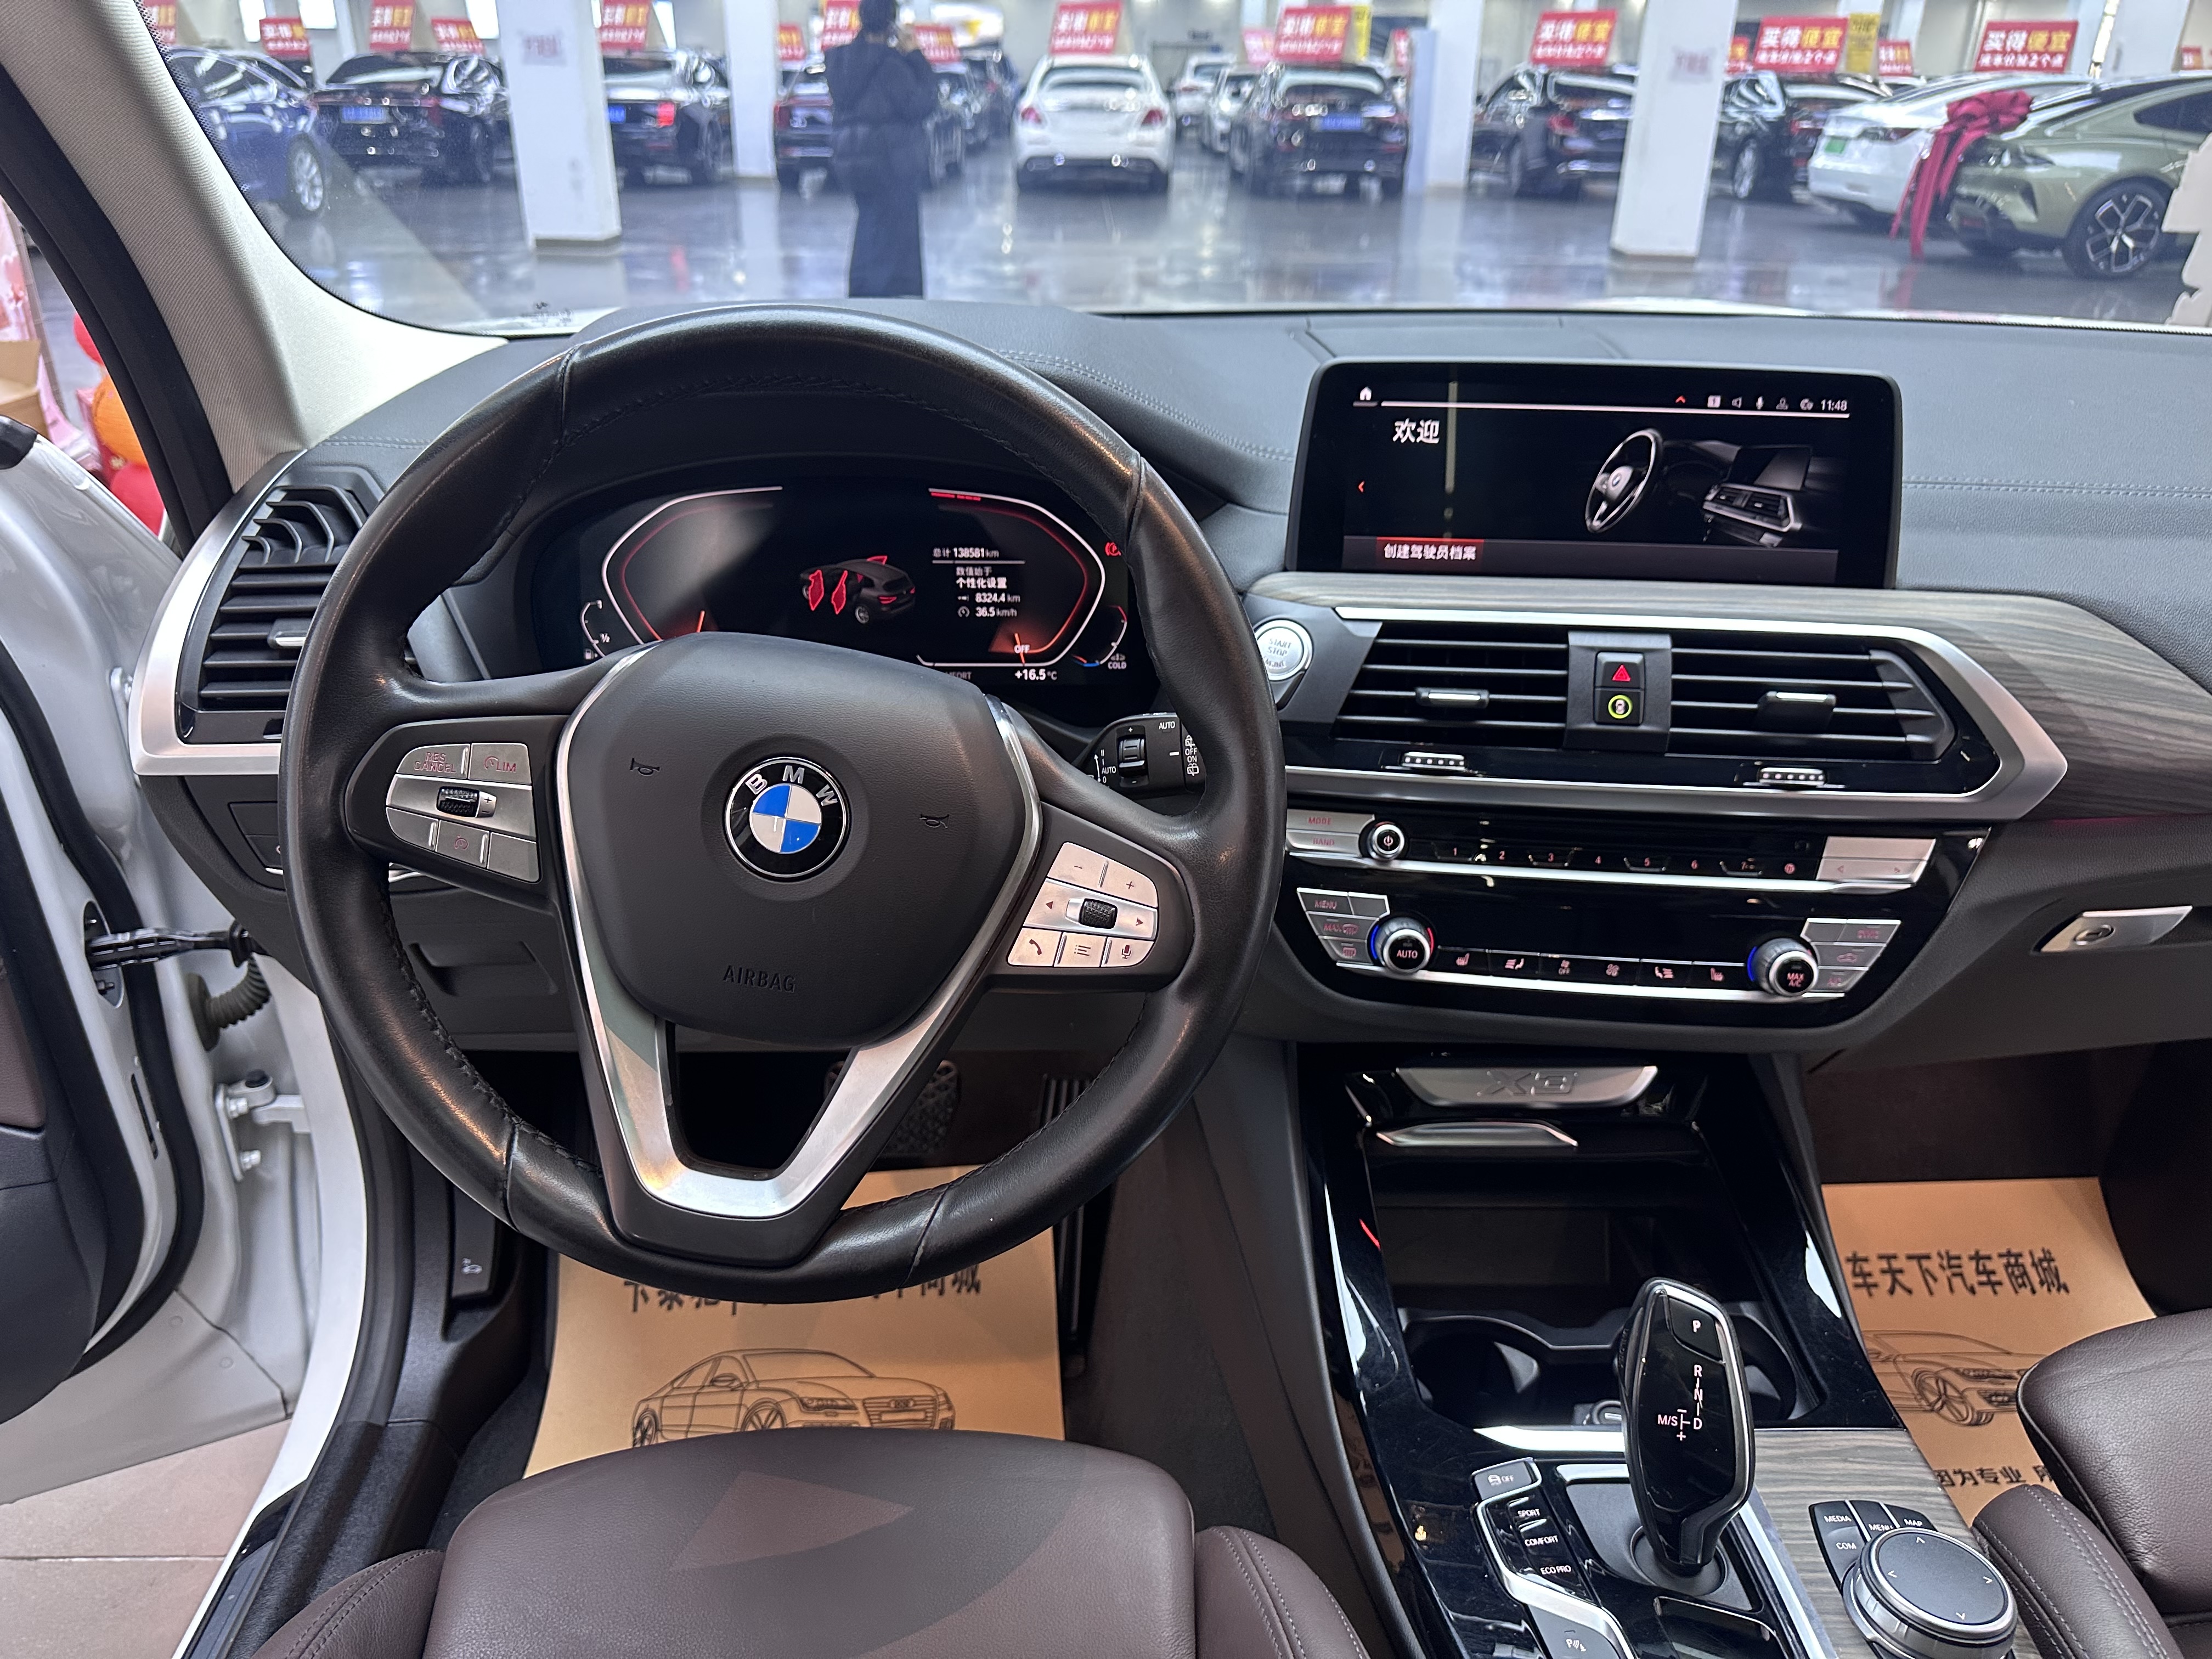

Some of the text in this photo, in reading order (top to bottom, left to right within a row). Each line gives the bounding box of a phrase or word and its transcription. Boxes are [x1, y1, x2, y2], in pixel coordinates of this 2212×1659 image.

[1821, 399, 1847, 411] 11:48
[1392, 417, 1440, 444] 欢迎
[953, 548, 985, 558] 138581
[1384, 543, 1477, 561] 创建驾驶员档案
[956, 577, 1007, 589] 个性化设置
[975, 592, 1021, 603] 8324.4 km
[975, 606, 995, 617] 36.5
[1014, 644, 1030, 653] OFF
[1158, 721, 1176, 730] AUTO
[1184, 747, 1198, 755] OFF
[426, 752, 447, 762] RES
[414, 761, 457, 774] CANCEL
[496, 762, 517, 772] LIM
[1101, 766, 1117, 774] AUTO
[745, 765, 838, 806] BMW
[1308, 817, 1332, 825] MODE
[1499, 851, 1505, 860] 2
[1548, 853, 1554, 862] 3
[1595, 856, 1601, 864] 4
[1314, 900, 1337, 910] MENU
[1397, 950, 1418, 959] AUTO
[723, 965, 795, 994] AIRBAG
[1845, 1247, 2070, 1298] 车天下汽车商城
[1692, 1320, 1701, 1333] P
[1694, 1364, 1702, 1377] R
[1694, 1389, 1703, 1401] N
[1657, 1414, 1678, 1426] M/S
[1693, 1418, 1702, 1430] D
[1933, 1465, 2027, 1487] 因为专业
[1517, 1509, 1541, 1517] SPORT
[1904, 1519, 1923, 1527] MAP
[1524, 1535, 1559, 1547] COMFORT
[1540, 1565, 1572, 1575] ECO PRO
